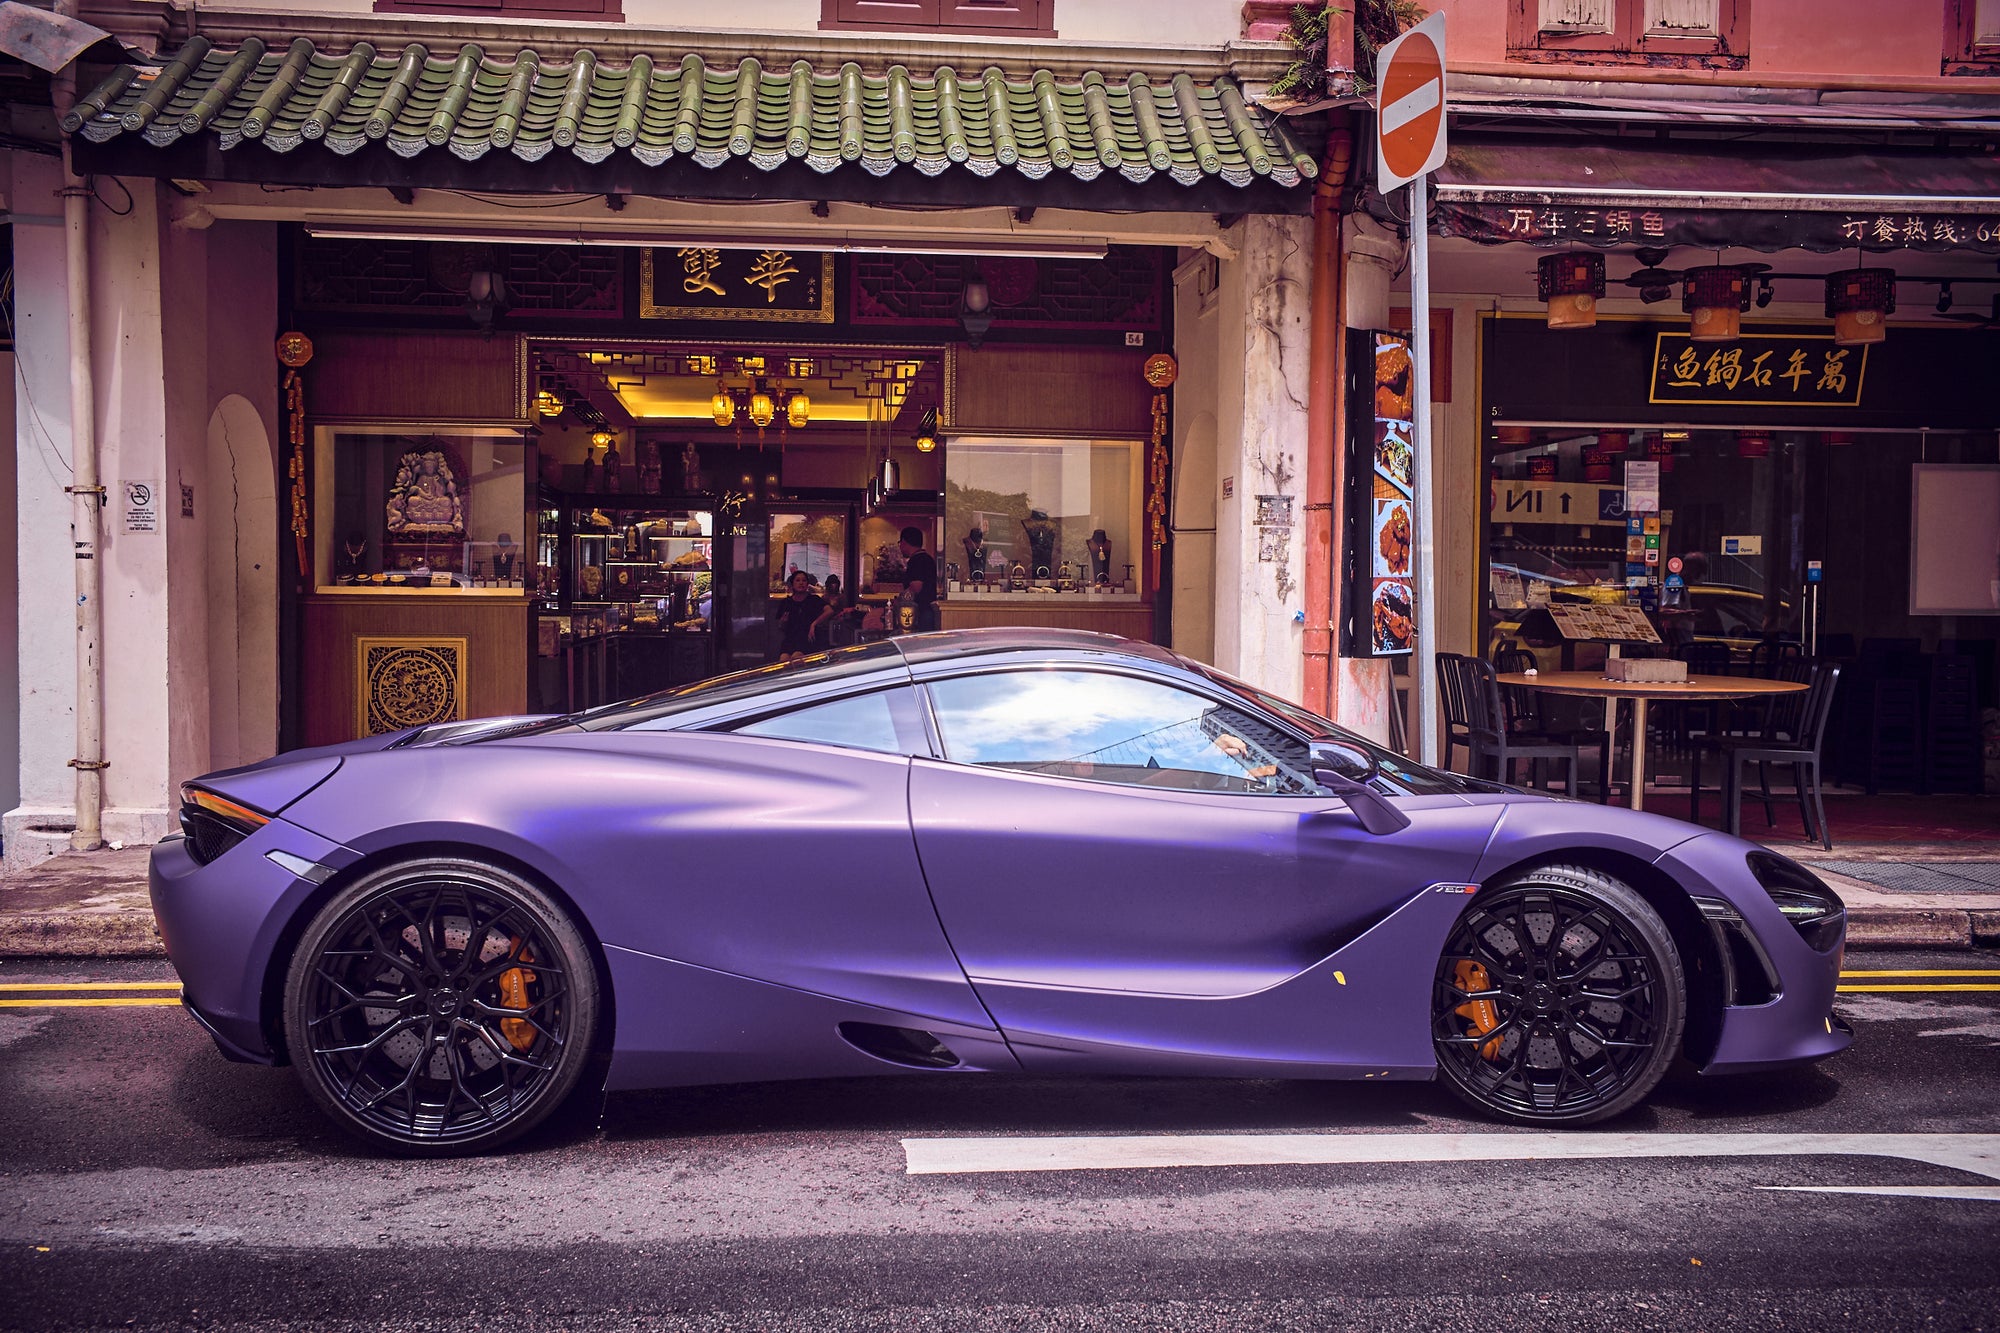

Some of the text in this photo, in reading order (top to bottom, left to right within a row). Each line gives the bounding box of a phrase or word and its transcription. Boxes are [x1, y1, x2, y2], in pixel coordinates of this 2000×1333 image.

[1128, 334, 1141, 344] 54
[1491, 406, 1503, 416] 52
[1529, 874, 1587, 888] MICHELIN
[1436, 885, 1477, 894] 720S
